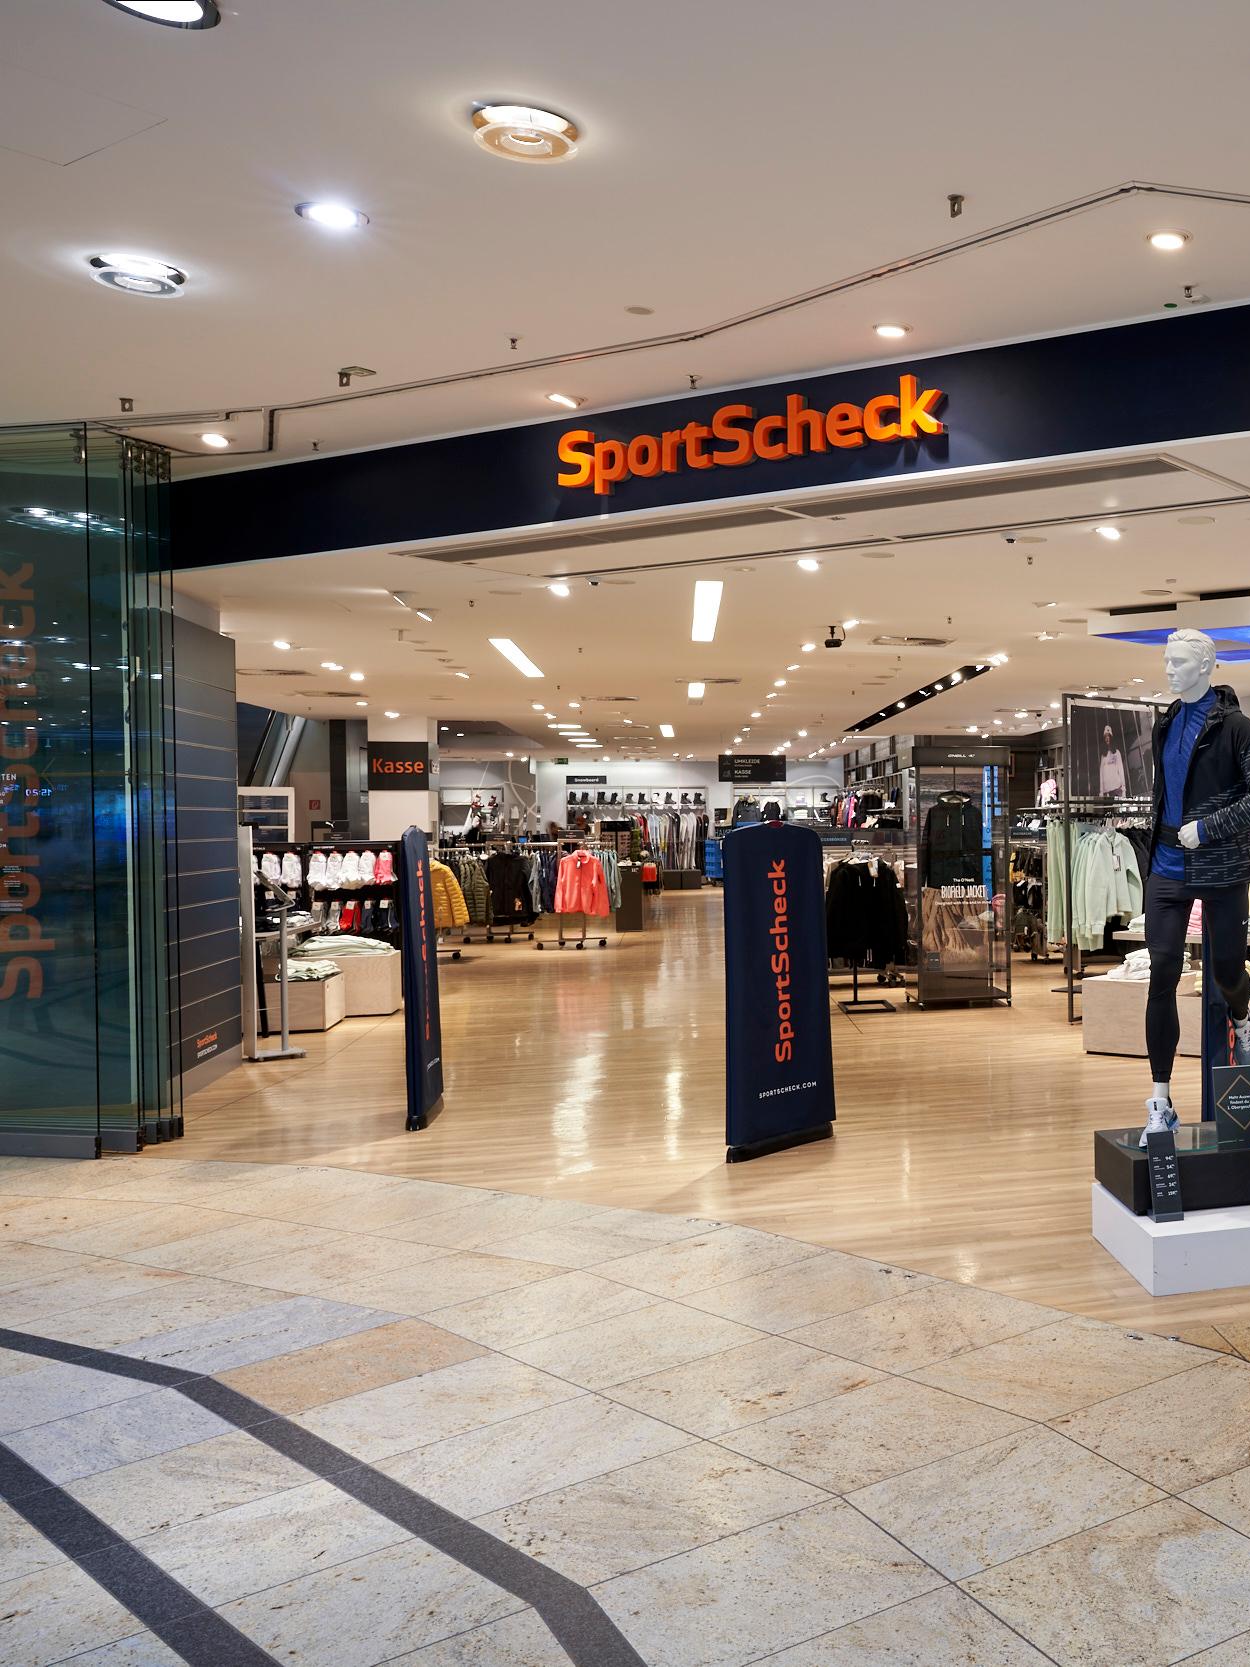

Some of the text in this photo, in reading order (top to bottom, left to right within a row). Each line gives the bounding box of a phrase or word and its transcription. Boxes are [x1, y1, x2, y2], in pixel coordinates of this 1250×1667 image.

[557, 373, 944, 496] SportScheck
[372, 757, 425, 775] Kasse
[0, 773, 17, 781] TEN
[966, 885, 986, 898] JACKET
[767, 859, 793, 1063] SportScheck
[758, 1080, 817, 1099] SPORTSCHECK.COM
